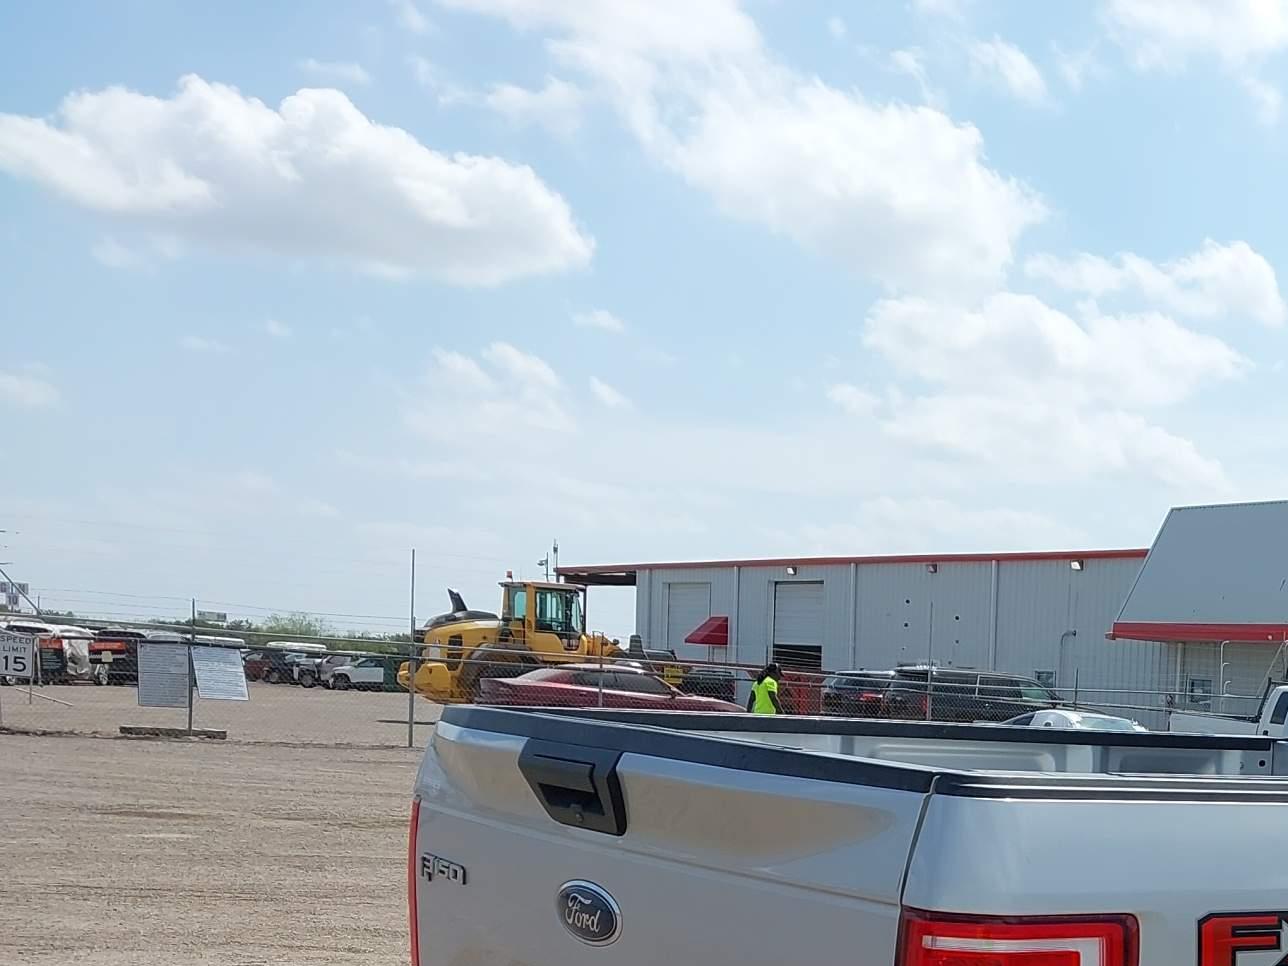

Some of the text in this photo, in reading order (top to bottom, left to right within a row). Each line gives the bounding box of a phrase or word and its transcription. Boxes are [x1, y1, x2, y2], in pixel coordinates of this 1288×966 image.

[0, 635, 31, 645] SPEED
[2, 645, 27, 653] LIMIT
[2, 655, 27, 673] 15
[566, 893, 601, 933] Ford
